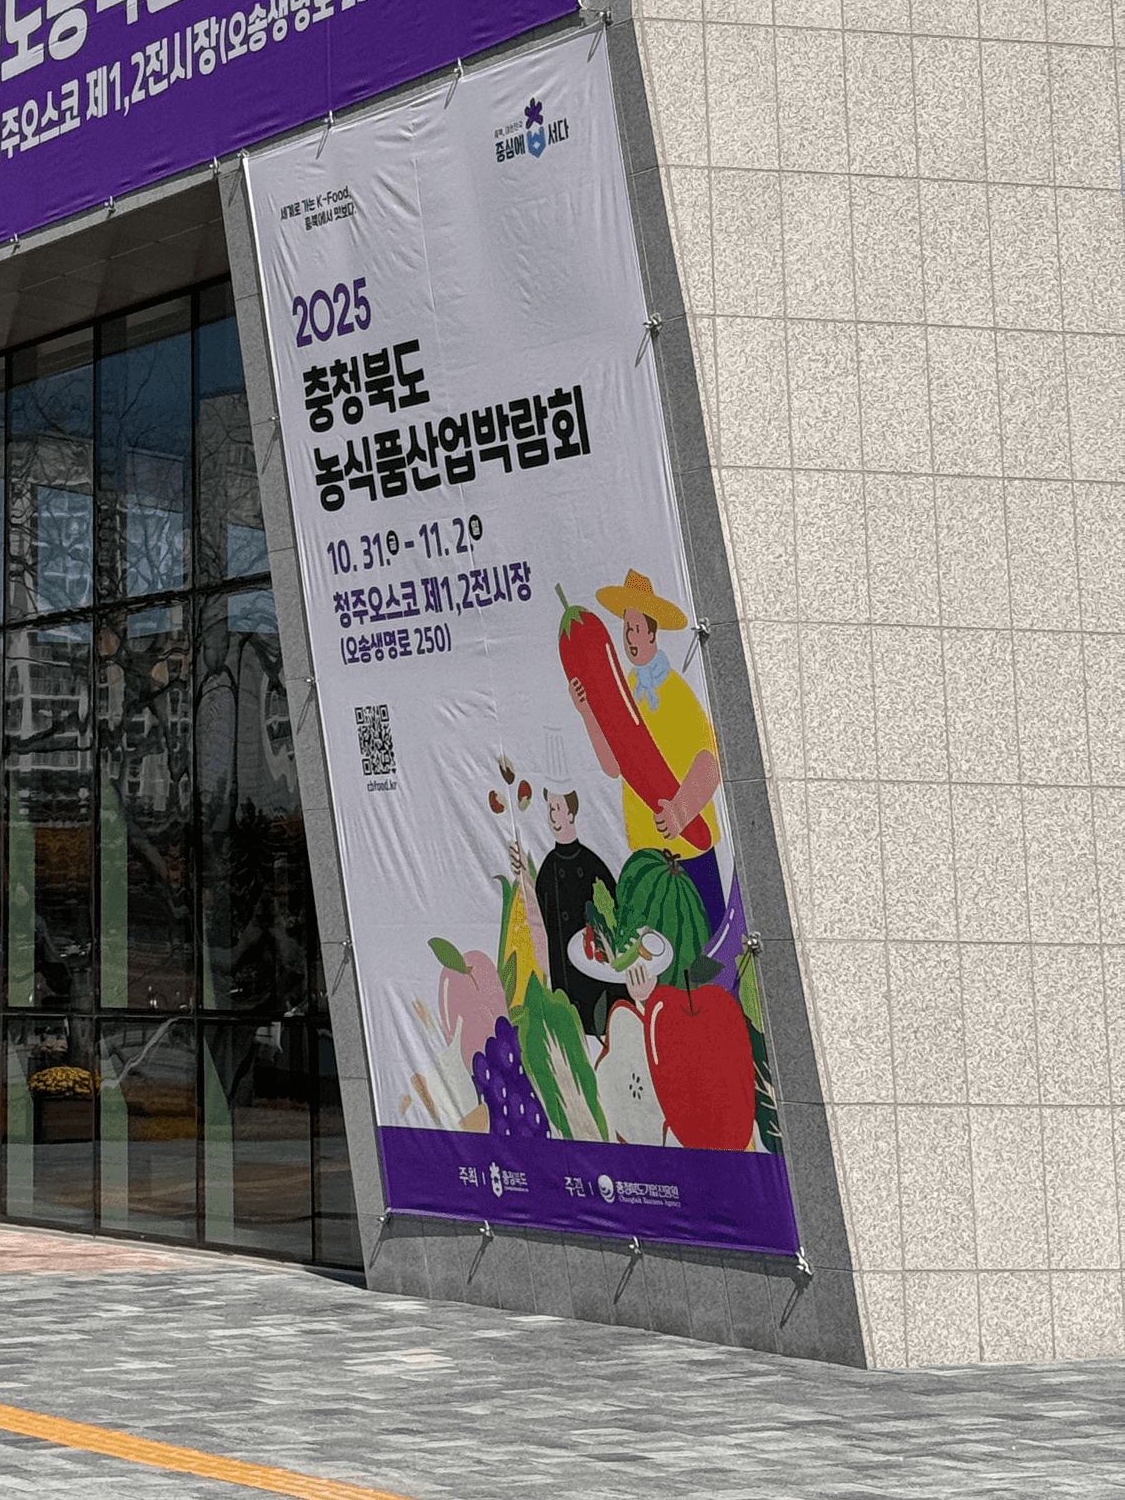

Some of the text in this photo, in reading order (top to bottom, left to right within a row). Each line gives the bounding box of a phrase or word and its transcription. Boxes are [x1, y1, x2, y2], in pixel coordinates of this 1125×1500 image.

[495, 118, 569, 163] 중심에 서다
[280, 202, 301, 221] 세계로
[301, 197, 316, 213] 가는
[305, 209, 333, 231] 충북에서
[292, 277, 371, 347] 2025
[302, 339, 430, 433] 충청북도
[313, 385, 591, 512] 농식품산업박람회
[327, 539, 357, 574] 10.
[419, 522, 450, 559] 11.
[333, 561, 532, 628] 청주오스코 제1,2전시장
[340, 623, 452, 665] (오송생명로 250)
[458, 1166, 479, 1188] 주최
[564, 1176, 586, 1197] 주관
